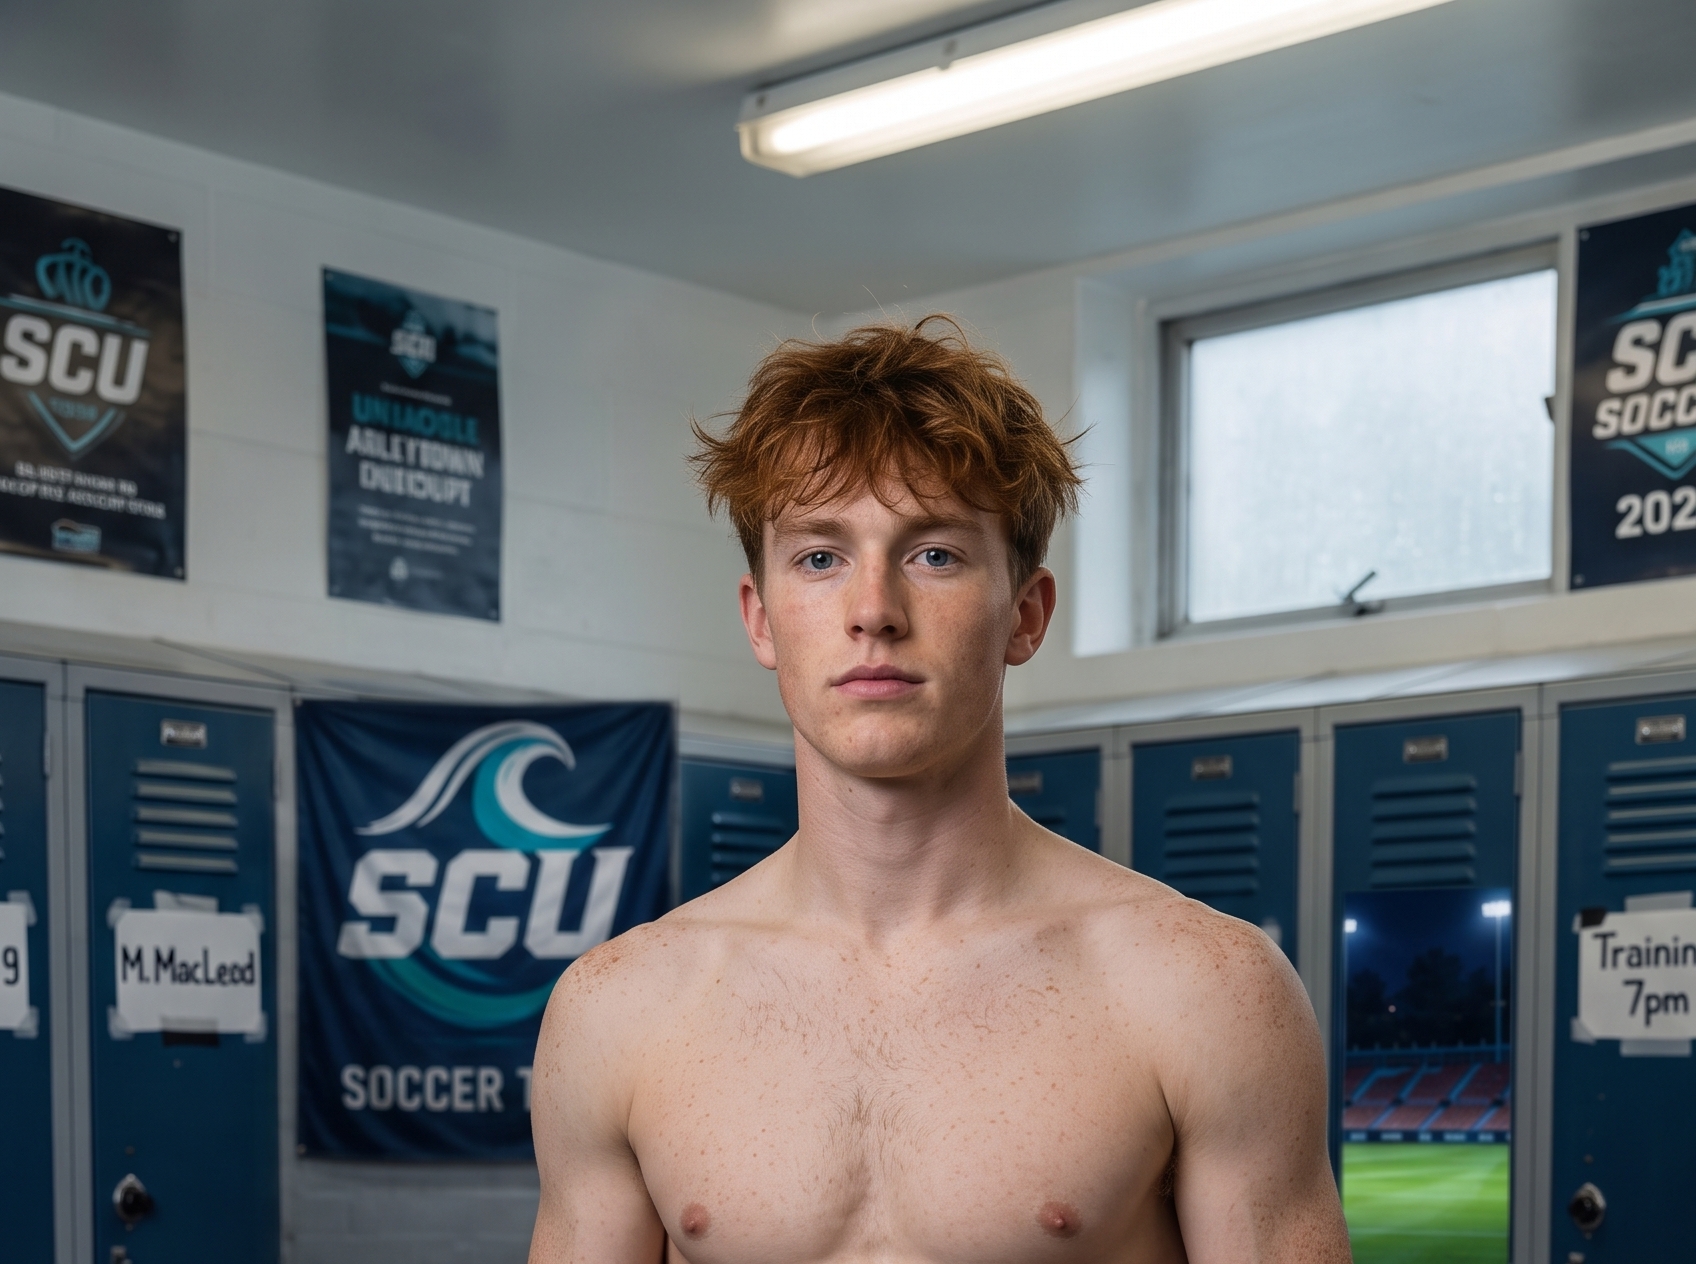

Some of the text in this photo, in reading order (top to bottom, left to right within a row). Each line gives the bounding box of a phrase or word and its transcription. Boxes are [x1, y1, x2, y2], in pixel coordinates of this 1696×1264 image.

[0, 313, 150, 405] SCU
[1605, 310, 1696, 394] SC
[1615, 485, 1696, 539] 202
[336, 846, 635, 960] SCU
[3, 945, 20, 986] 9
[1592, 931, 1696, 971] Trainin
[1623, 979, 1689, 1028] 7pm
[340, 1063, 504, 1113] SOCCER
